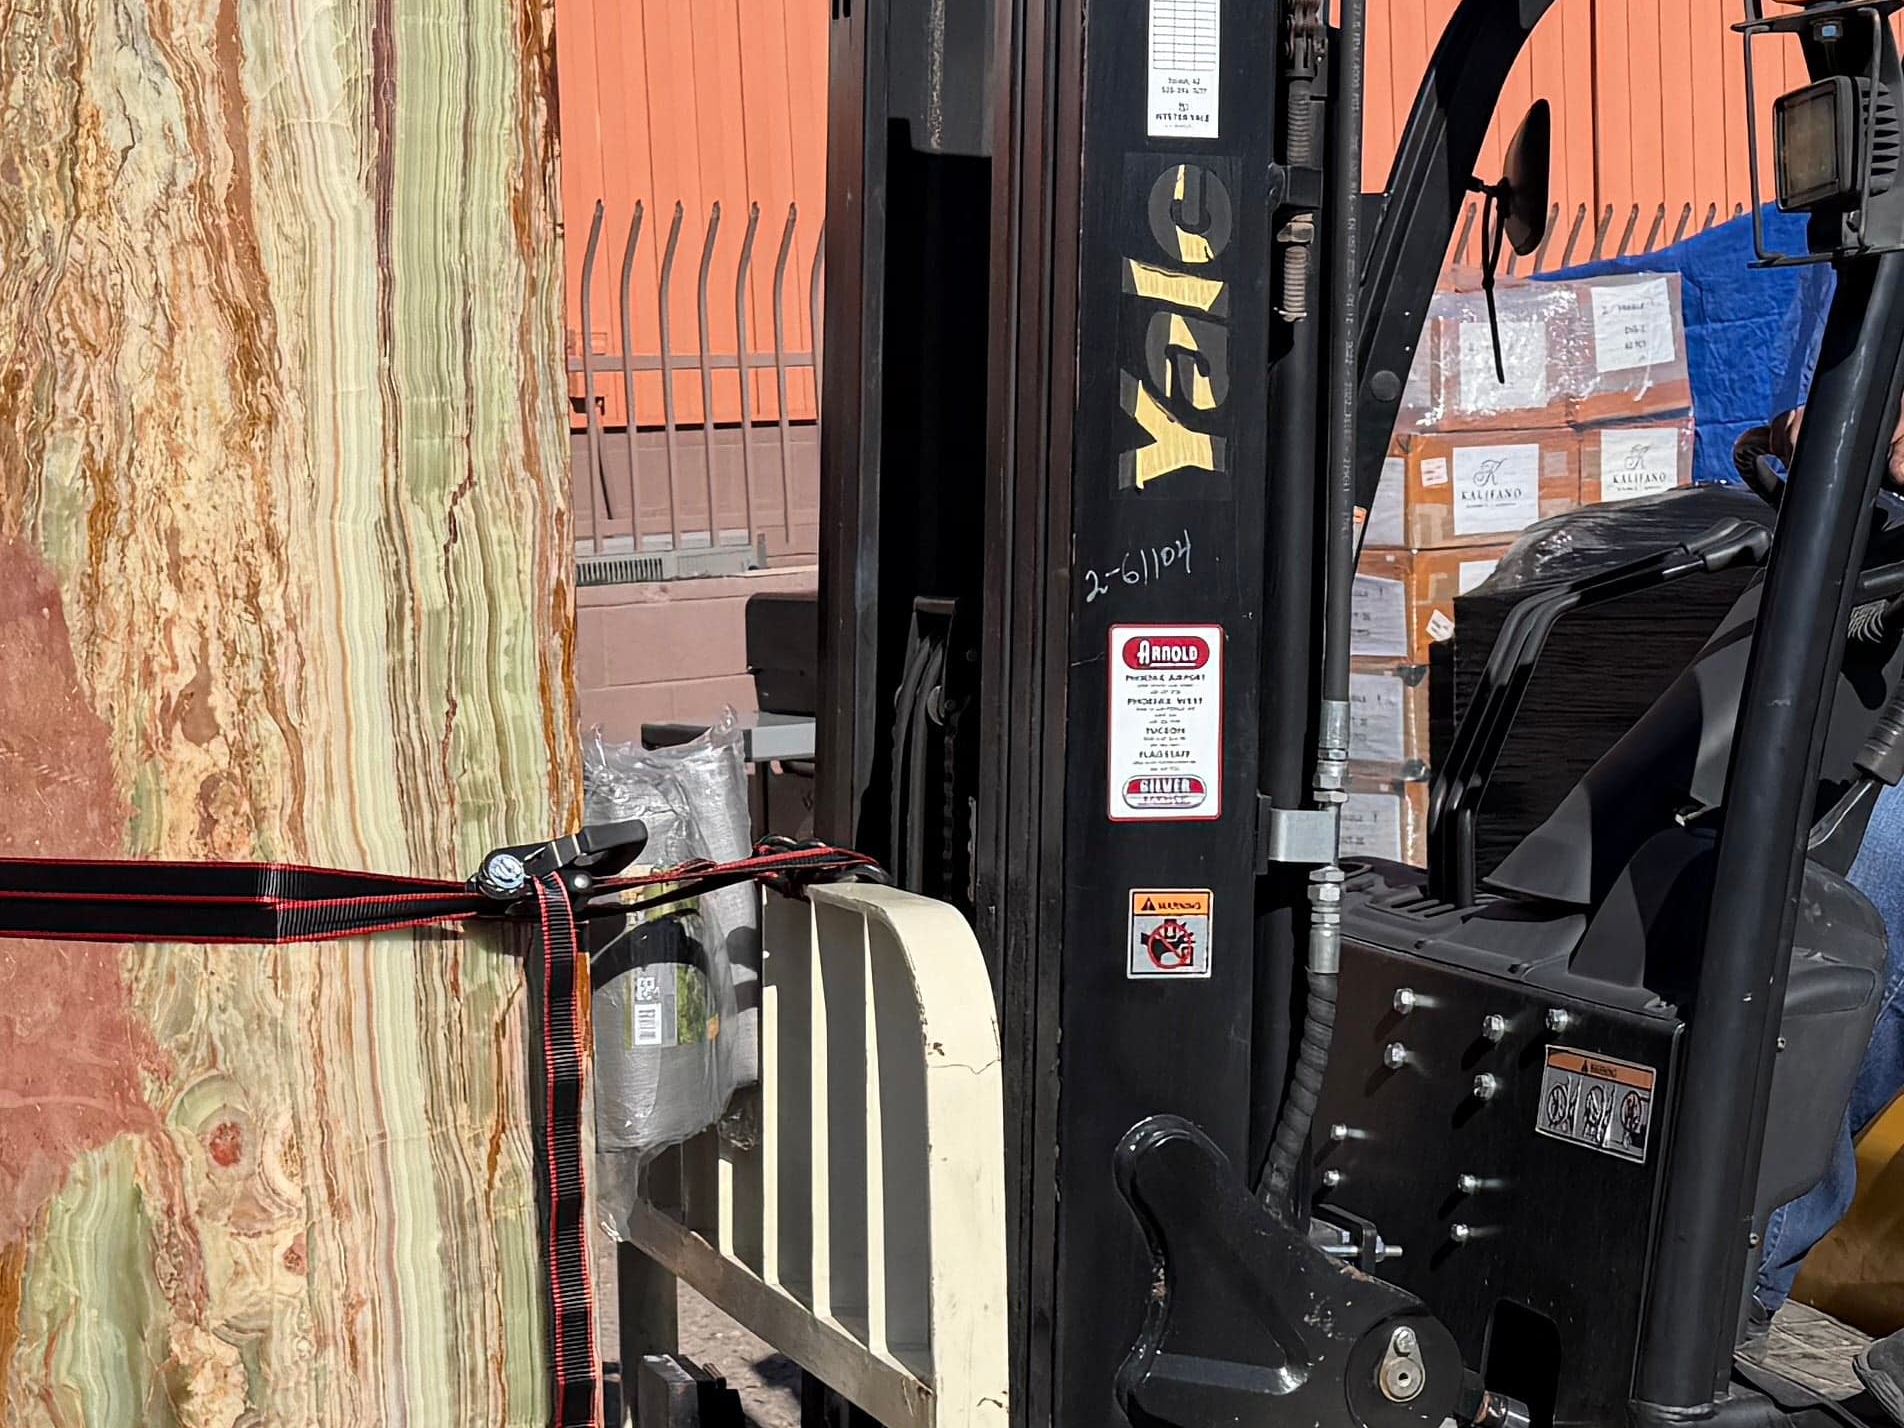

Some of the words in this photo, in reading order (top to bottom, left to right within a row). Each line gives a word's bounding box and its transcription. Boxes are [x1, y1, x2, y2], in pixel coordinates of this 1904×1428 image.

[1119, 164, 1232, 491] Yale
[1613, 472, 1667, 484] KALIFANO
[1461, 488, 1522, 501] KALIFANO
[1085, 529, 1192, 603] 2-61104
[1139, 778, 1191, 793] SILVER
